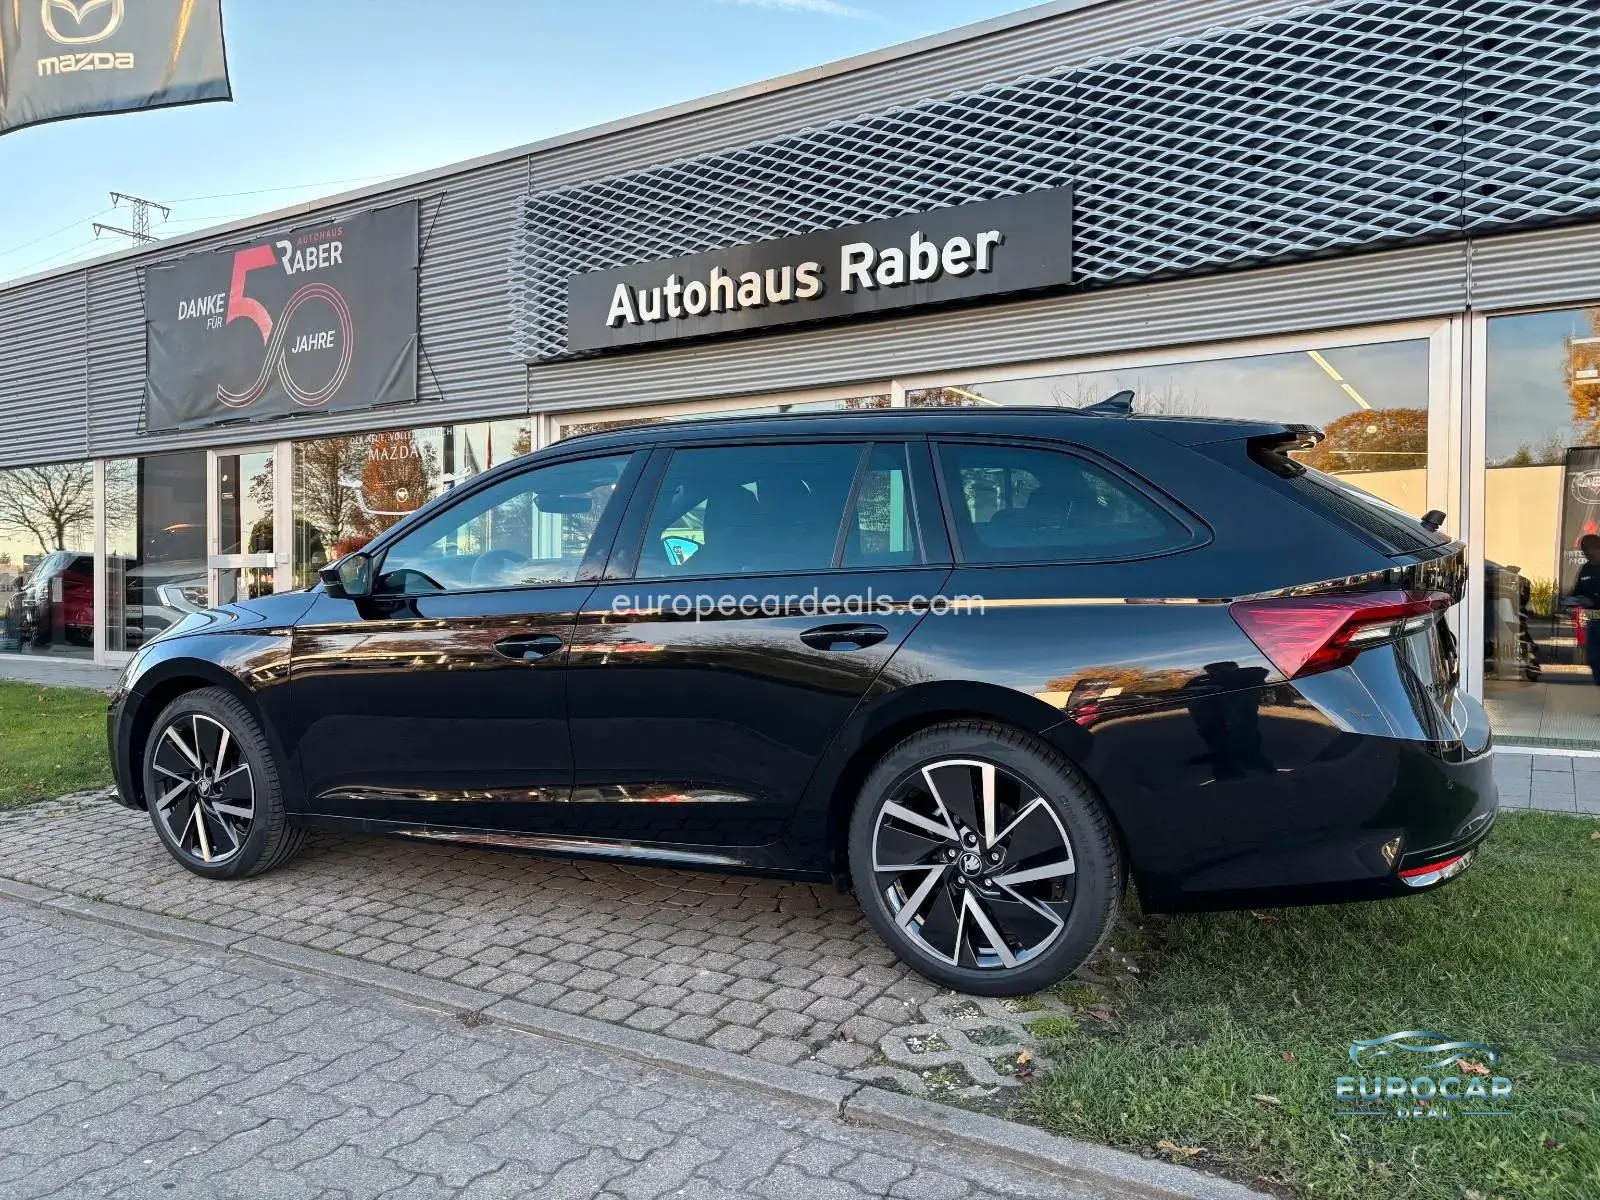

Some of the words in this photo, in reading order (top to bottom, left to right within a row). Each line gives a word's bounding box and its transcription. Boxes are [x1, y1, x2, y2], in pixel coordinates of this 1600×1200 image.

[297, 227, 343, 246] AUTOHAUS
[276, 239, 343, 275] RABER
[606, 261, 822, 328] Autohaus
[840, 228, 1003, 293] Raber
[178, 293, 226, 320] DANKE
[207, 316, 223, 331] FÜR
[292, 330, 336, 354] JAHRE
